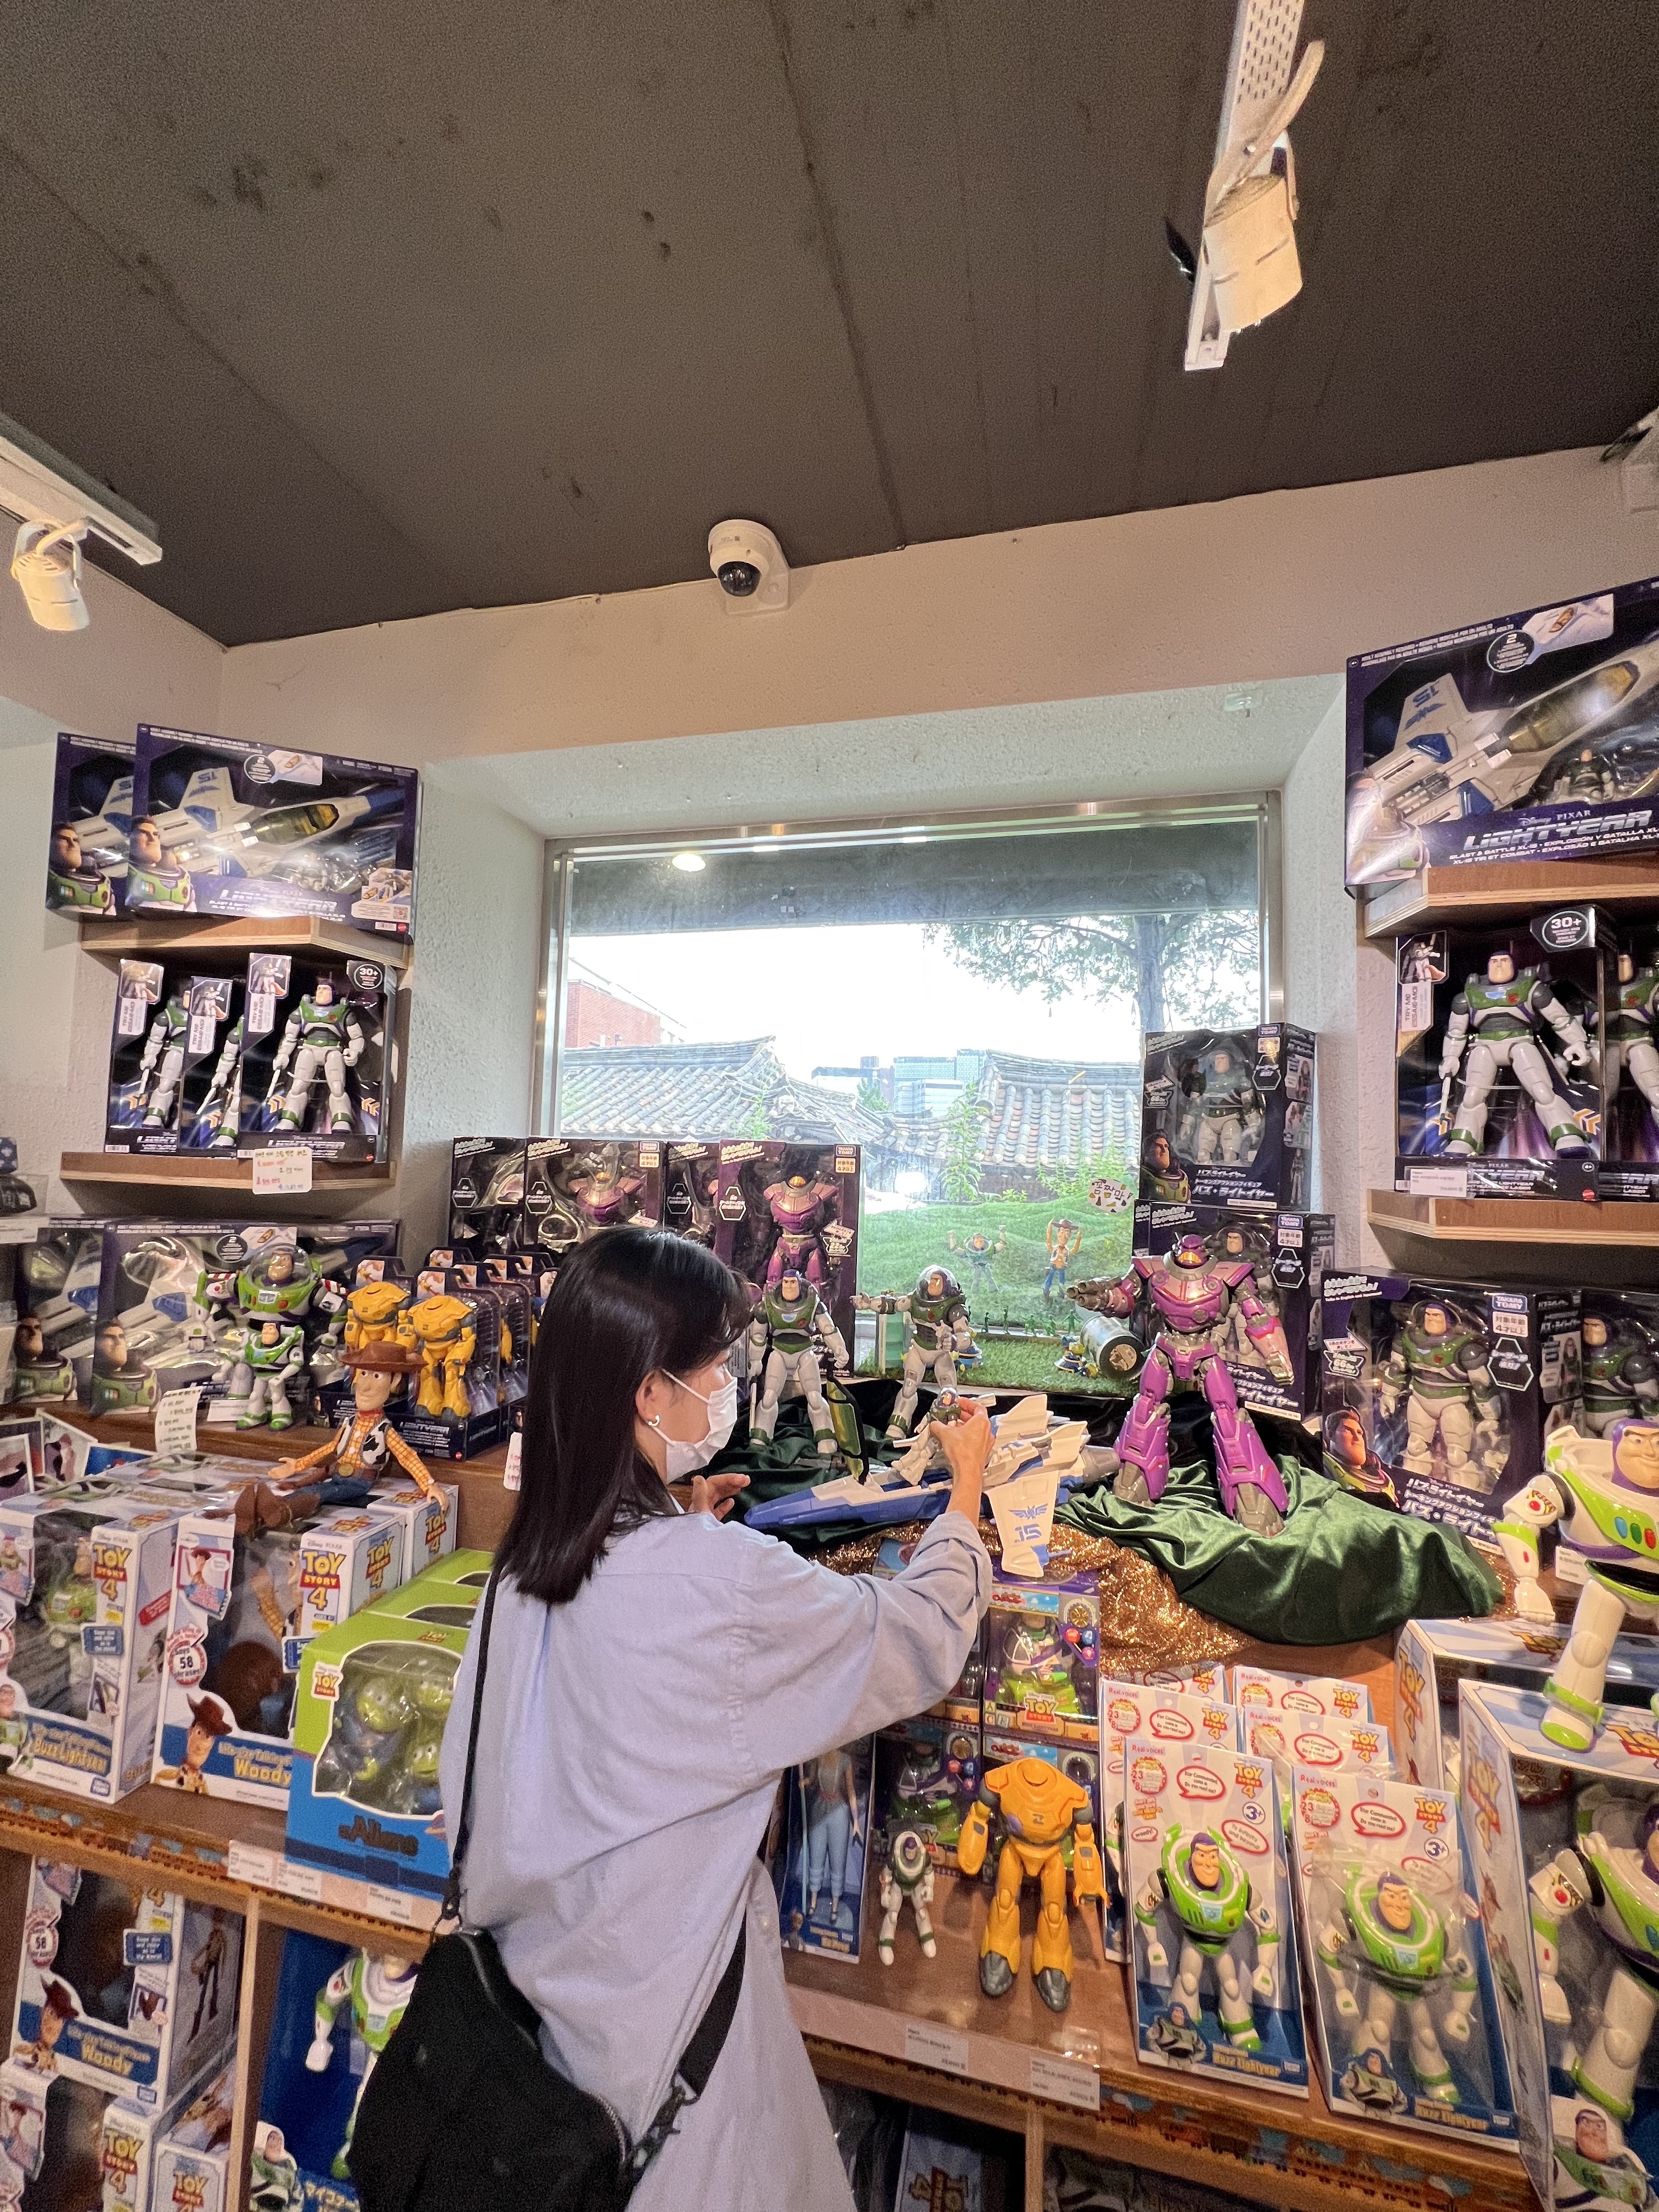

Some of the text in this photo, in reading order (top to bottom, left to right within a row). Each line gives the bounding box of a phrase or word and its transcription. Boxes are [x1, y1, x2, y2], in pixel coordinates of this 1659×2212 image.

[1557, 810, 1591, 821] PIXAR
[1484, 846, 1516, 855] BATTLE
[1551, 916, 1582, 929] 30+
[359, 967, 379, 977] 30+
[1404, 993, 1411, 1005] ME
[1496, 1301, 1523, 1310] TOMY
[1496, 1316, 1525, 1325] 対象年齢
[1495, 1325, 1525, 1335] 4才以上
[1014, 1523, 1042, 1543] 15
[92, 1543, 133, 1568] TOY
[367, 1536, 394, 1564] TOY
[302, 1550, 347, 1576] TOY
[303, 1574, 338, 1586] STORY
[101, 1578, 118, 1601] 4
[307, 1586, 328, 1611] 4
[179, 1656, 194, 1670] 58
[315, 1672, 339, 1689] TOY
[1398, 1647, 1426, 1701] TOY
[1108, 1687, 1121, 1696] Real
[1198, 1682, 1210, 1694] 4
[1333, 1688, 1360, 1702] TOY
[1025, 1697, 1057, 1715] TOY
[1241, 1695, 1251, 1703] 23
[1108, 1709, 1119, 1719] 23
[1201, 1707, 1229, 1723] TOY
[1339, 1706, 1352, 1719] 4
[1403, 1703, 1417, 1743] 4
[1209, 1727, 1221, 1740] 4
[1350, 1730, 1380, 1745] TOY
[1606, 1724, 1659, 1750] TO
[1132, 1744, 1146, 1753] Real
[1358, 1750, 1372, 1763] 4
[234, 1758, 291, 1786] Woody
[1132, 1770, 1143, 1780] 23
[1234, 1762, 1265, 1779] TOY
[1300, 1774, 1315, 1784] Real
[1242, 1785, 1255, 1799] 4
[1300, 1801, 1314, 1812] 23
[1414, 1796, 1447, 1814] TOY
[1246, 1805, 1263, 1821] 3+
[1423, 1820, 1438, 1835] 4
[1427, 1841, 1447, 1857] 3+
[105, 2130, 144, 2160] TOY
[109, 2169, 127, 2195] 4
[173, 2171, 210, 2194] TOY
